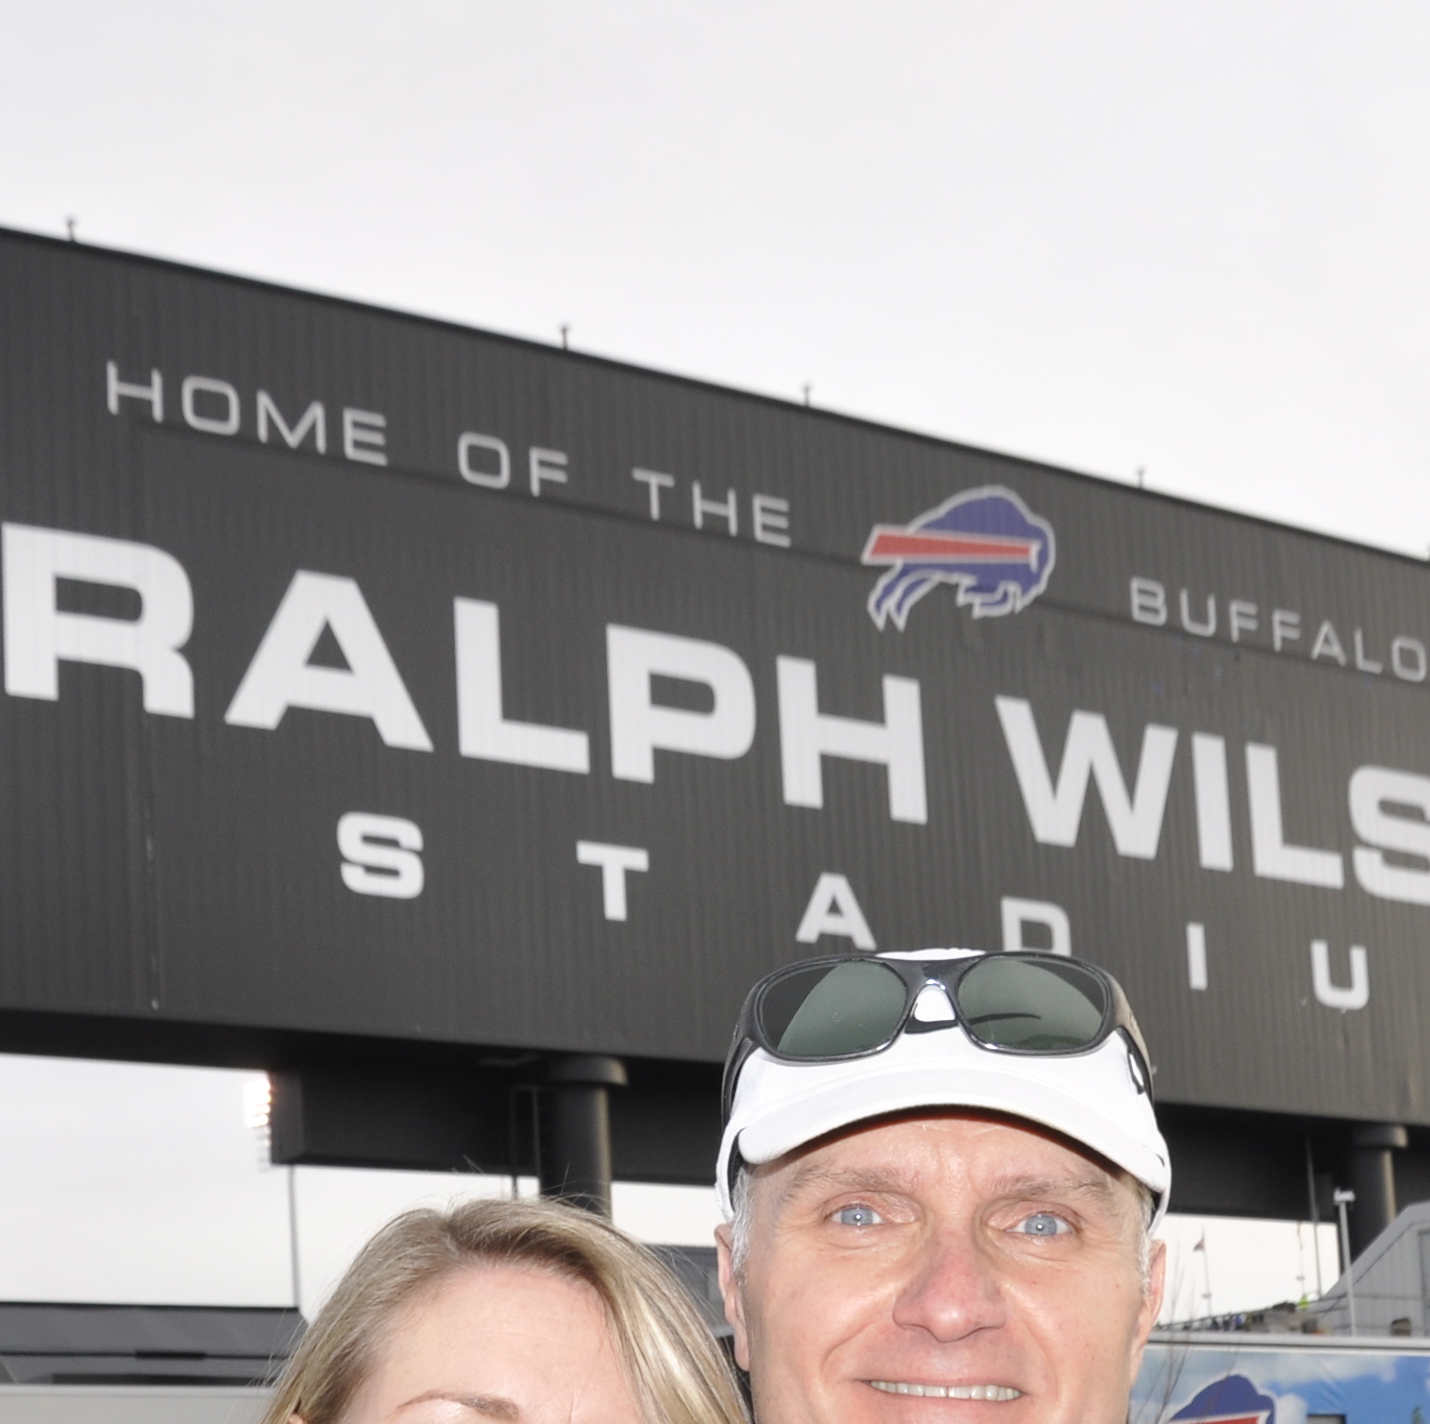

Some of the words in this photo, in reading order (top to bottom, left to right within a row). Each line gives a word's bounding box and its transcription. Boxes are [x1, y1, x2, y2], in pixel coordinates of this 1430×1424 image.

[0, 521, 928, 825] RALPH
[106, 361, 388, 466] HOME
[457, 432, 568, 497] OF
[632, 467, 791, 548] THE
[1129, 576, 1428, 682] BUFFALO
